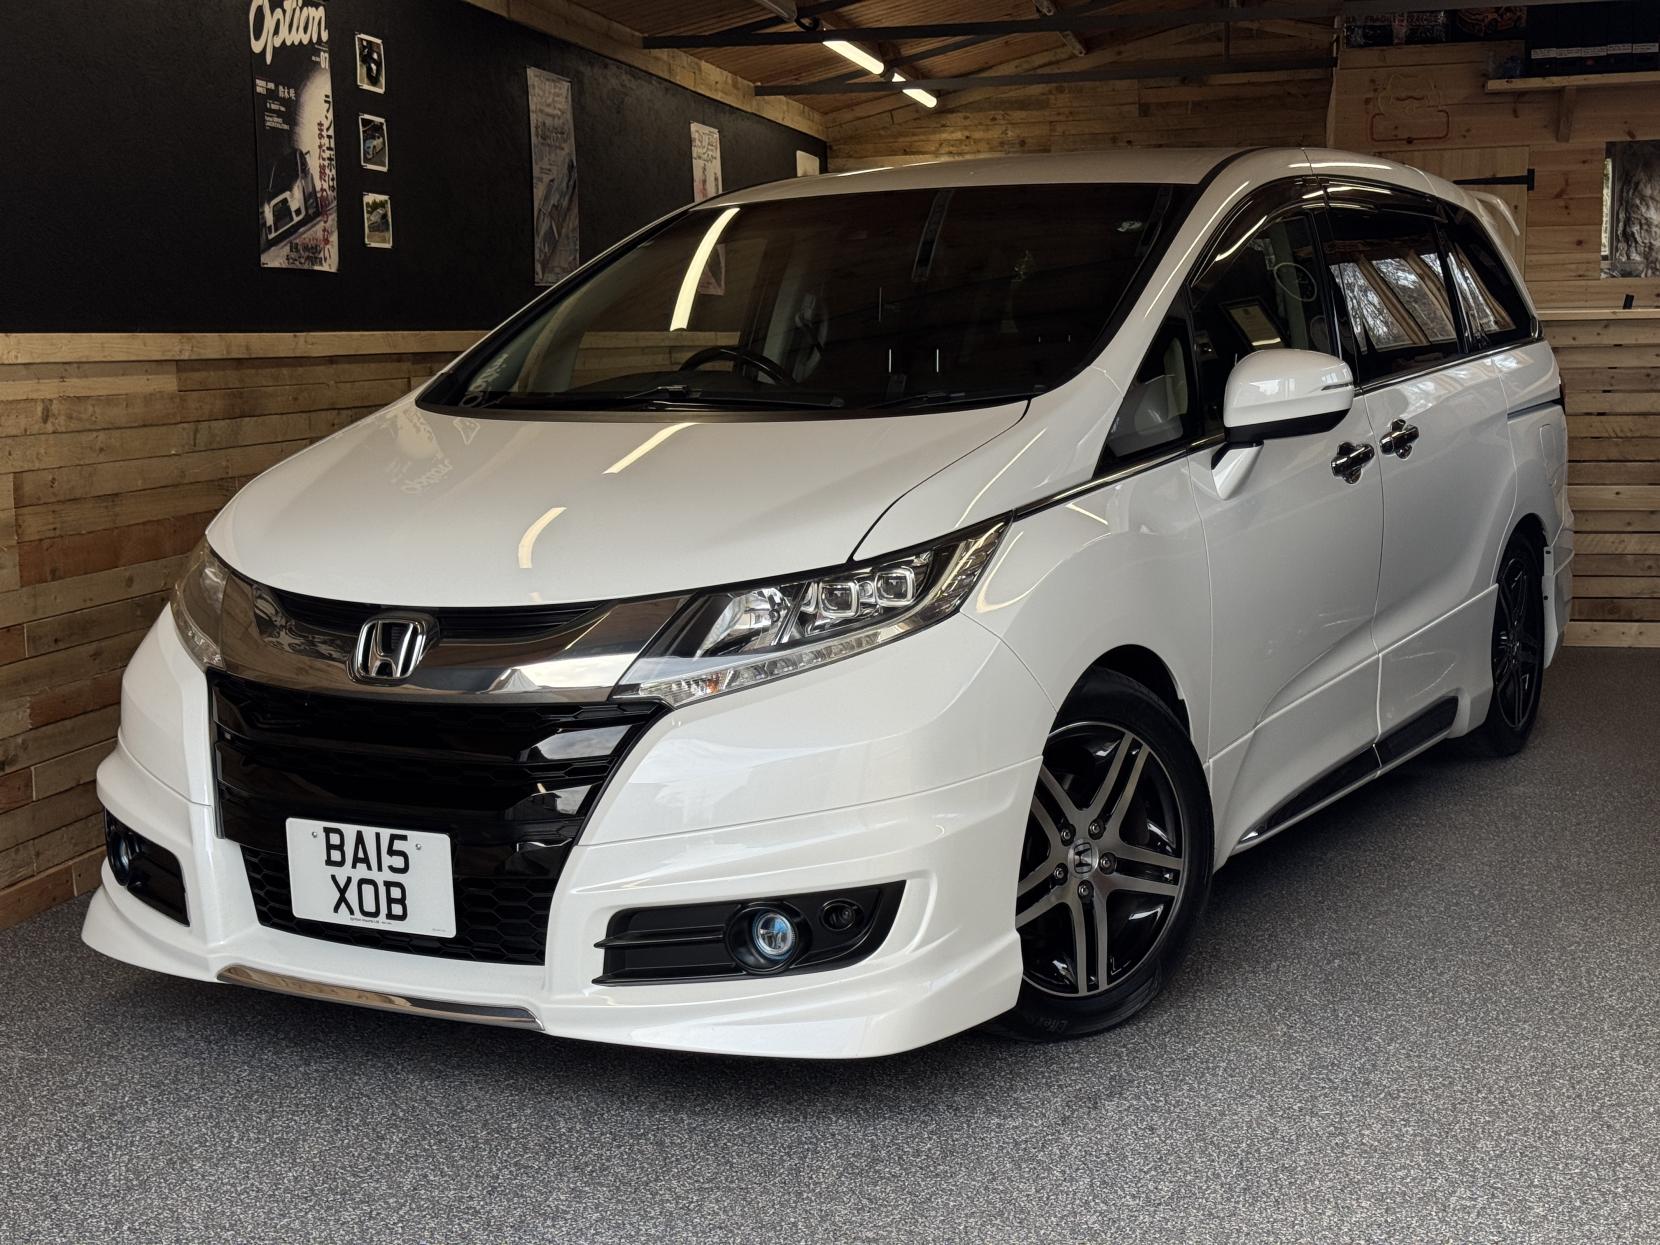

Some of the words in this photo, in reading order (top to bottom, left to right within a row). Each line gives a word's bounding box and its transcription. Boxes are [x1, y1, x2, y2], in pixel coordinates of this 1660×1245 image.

[249, 0, 329, 65] Option
[323, 826, 410, 875] BA15
[330, 873, 408, 922] XOB
